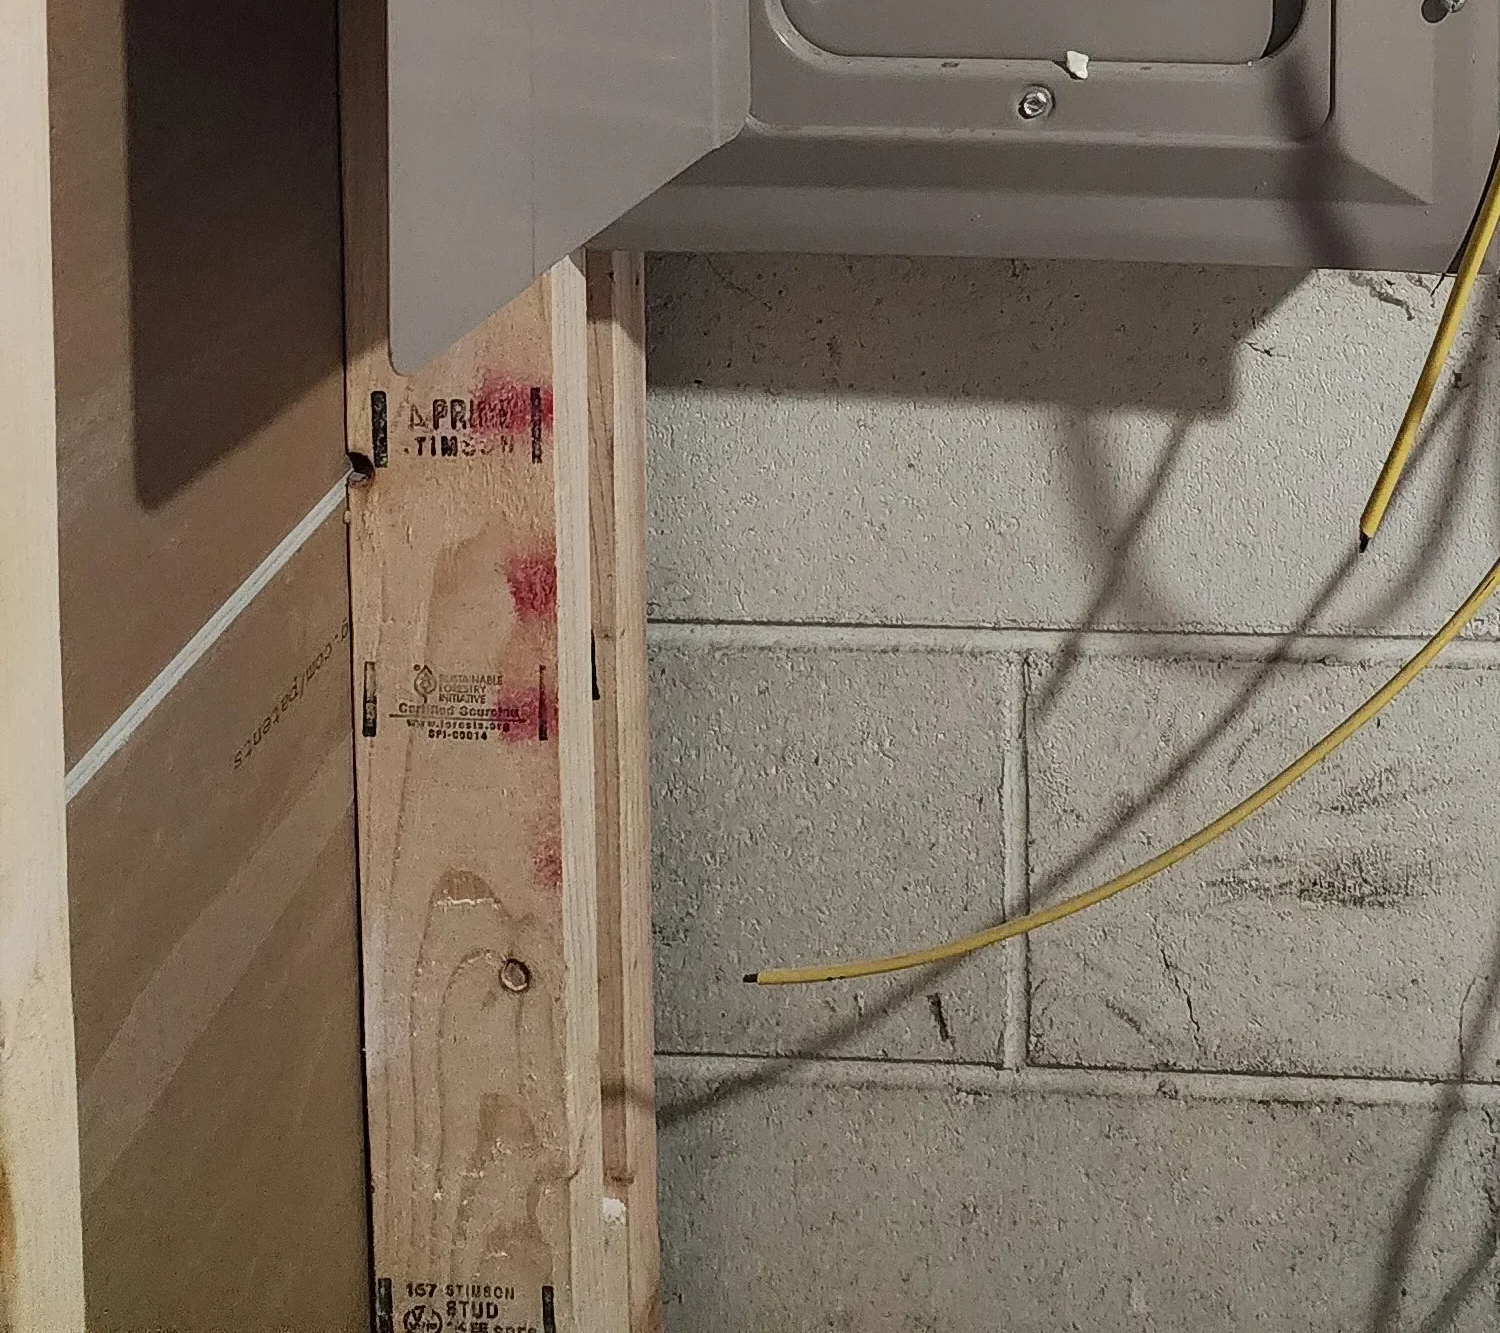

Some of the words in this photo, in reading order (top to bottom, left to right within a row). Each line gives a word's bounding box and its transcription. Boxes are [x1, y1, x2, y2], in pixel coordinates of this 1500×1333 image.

[405, 1282, 438, 1298] 167
[444, 1284, 515, 1300] STIMSON
[445, 1300, 499, 1319] STUD
